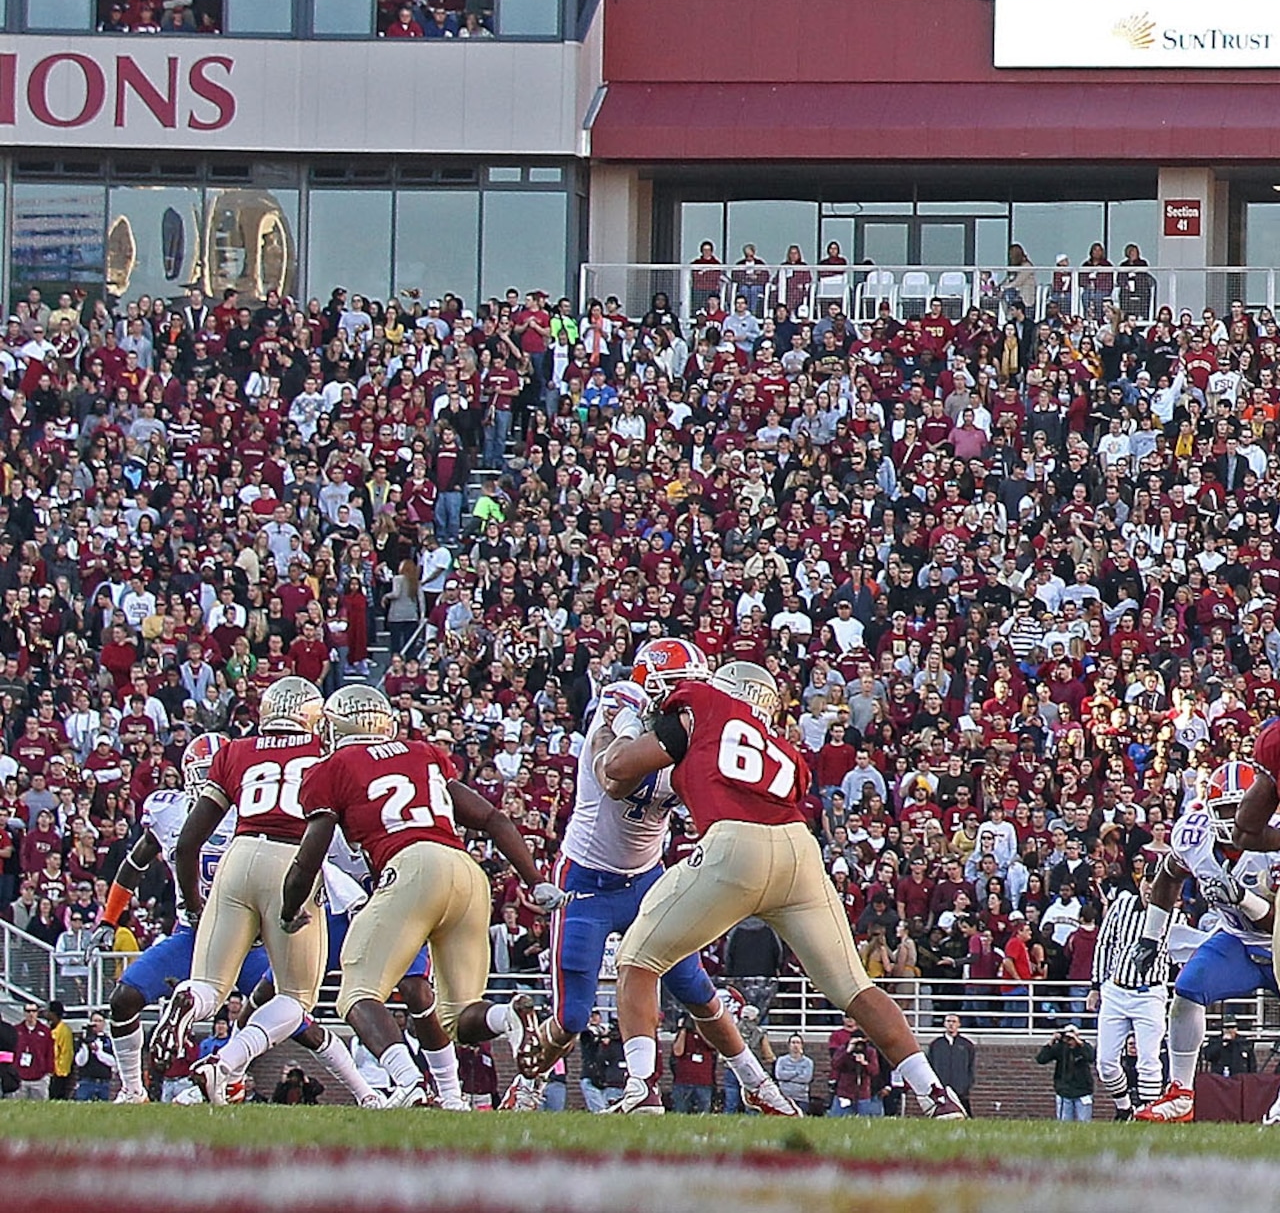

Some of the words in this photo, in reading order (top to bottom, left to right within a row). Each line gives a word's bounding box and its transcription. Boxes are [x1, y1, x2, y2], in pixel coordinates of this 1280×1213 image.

[1166, 205, 1199, 218] Section
[1176, 219, 1188, 231] 41
[366, 740, 410, 761] PRYOR
[717, 718, 797, 799] 67
